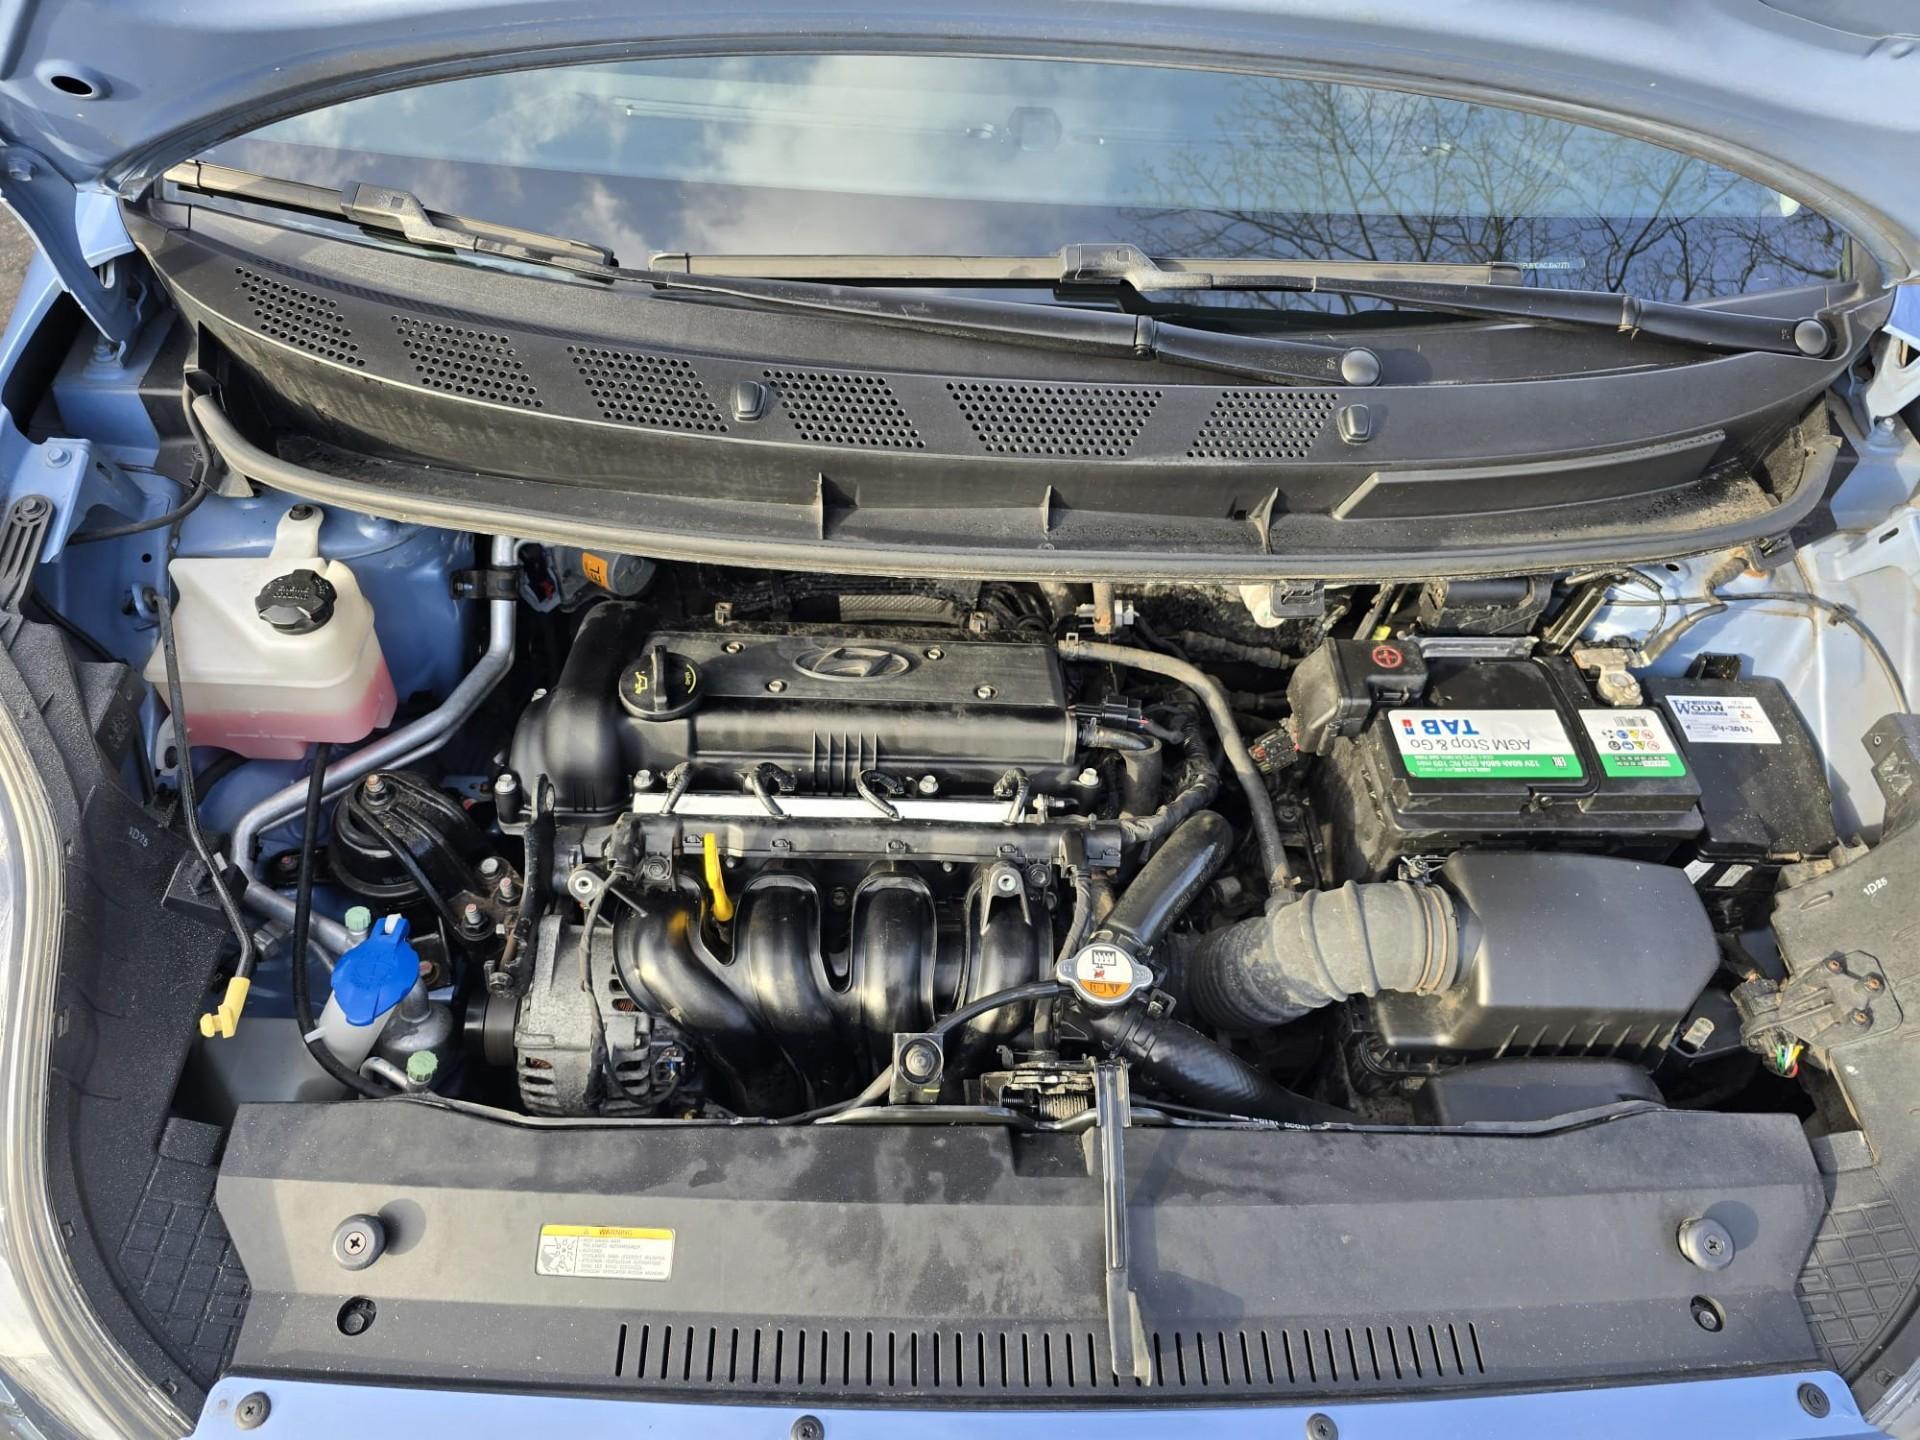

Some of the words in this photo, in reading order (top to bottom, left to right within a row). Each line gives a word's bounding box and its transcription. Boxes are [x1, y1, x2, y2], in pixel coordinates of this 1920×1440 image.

[1421, 719, 1479, 735] TAB
[1410, 739, 1433, 750] Go
[1435, 739, 1447, 750] &
[1451, 737, 1489, 750] Stop
[1492, 739, 1531, 750] AGM
